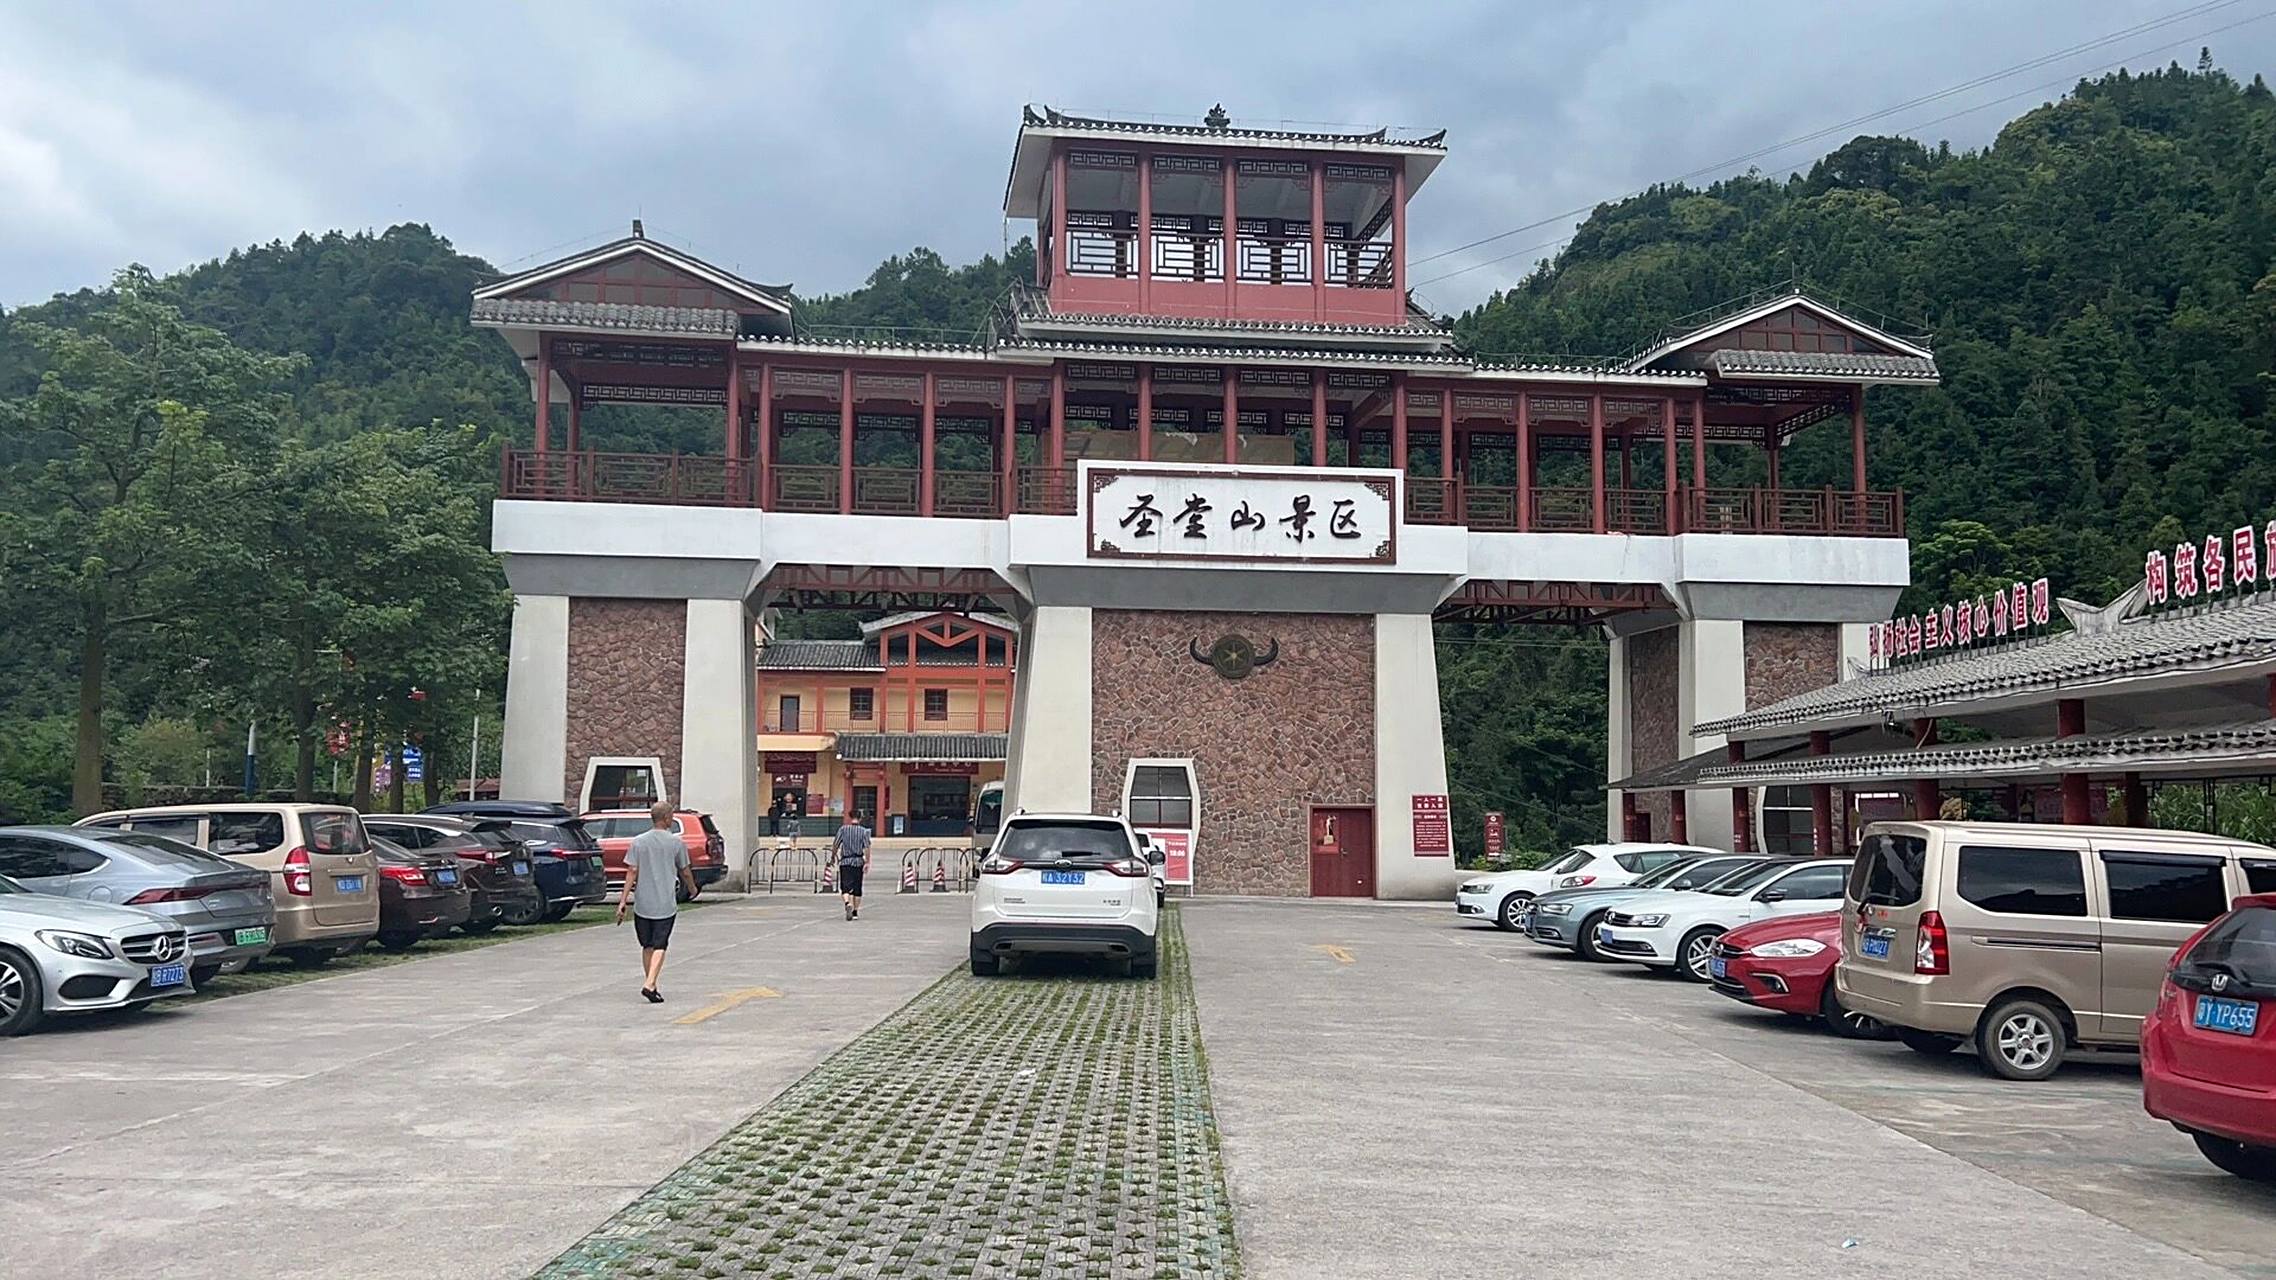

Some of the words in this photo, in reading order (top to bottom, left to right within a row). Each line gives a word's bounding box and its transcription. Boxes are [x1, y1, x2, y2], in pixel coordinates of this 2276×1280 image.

[1119, 493, 1362, 543] 圣堂山景区
[1869, 577, 2048, 660] 弘扬社会主义核心价值观
